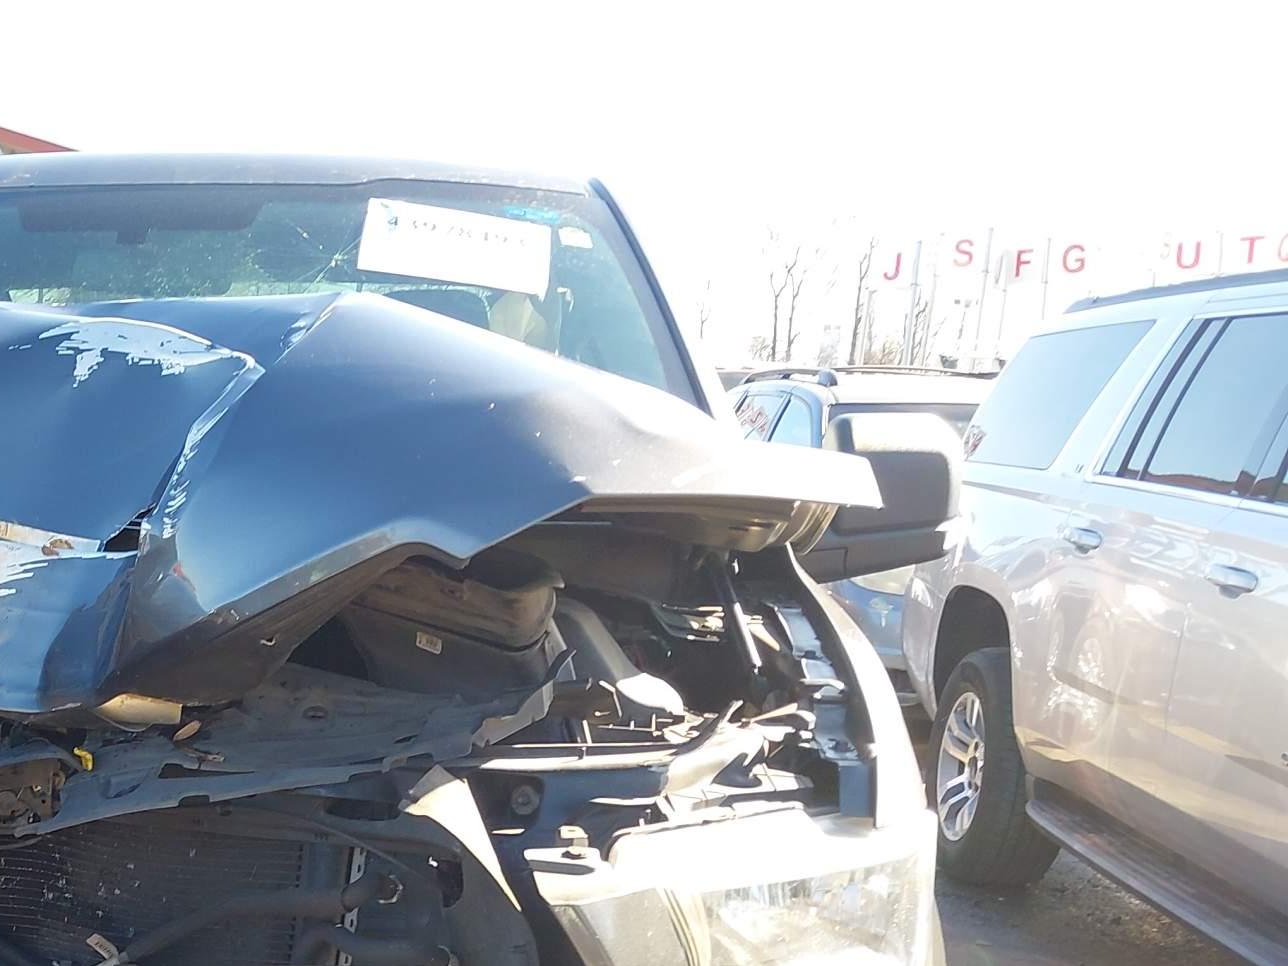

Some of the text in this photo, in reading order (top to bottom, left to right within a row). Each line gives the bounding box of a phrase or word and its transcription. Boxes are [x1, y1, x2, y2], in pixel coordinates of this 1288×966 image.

[952, 238, 974, 268] S
[1013, 248, 1035, 278] F
[1062, 244, 1086, 274] G
[1176, 240, 1202, 270] U
[1239, 235, 1265, 264] T
[883, 251, 902, 281] J
